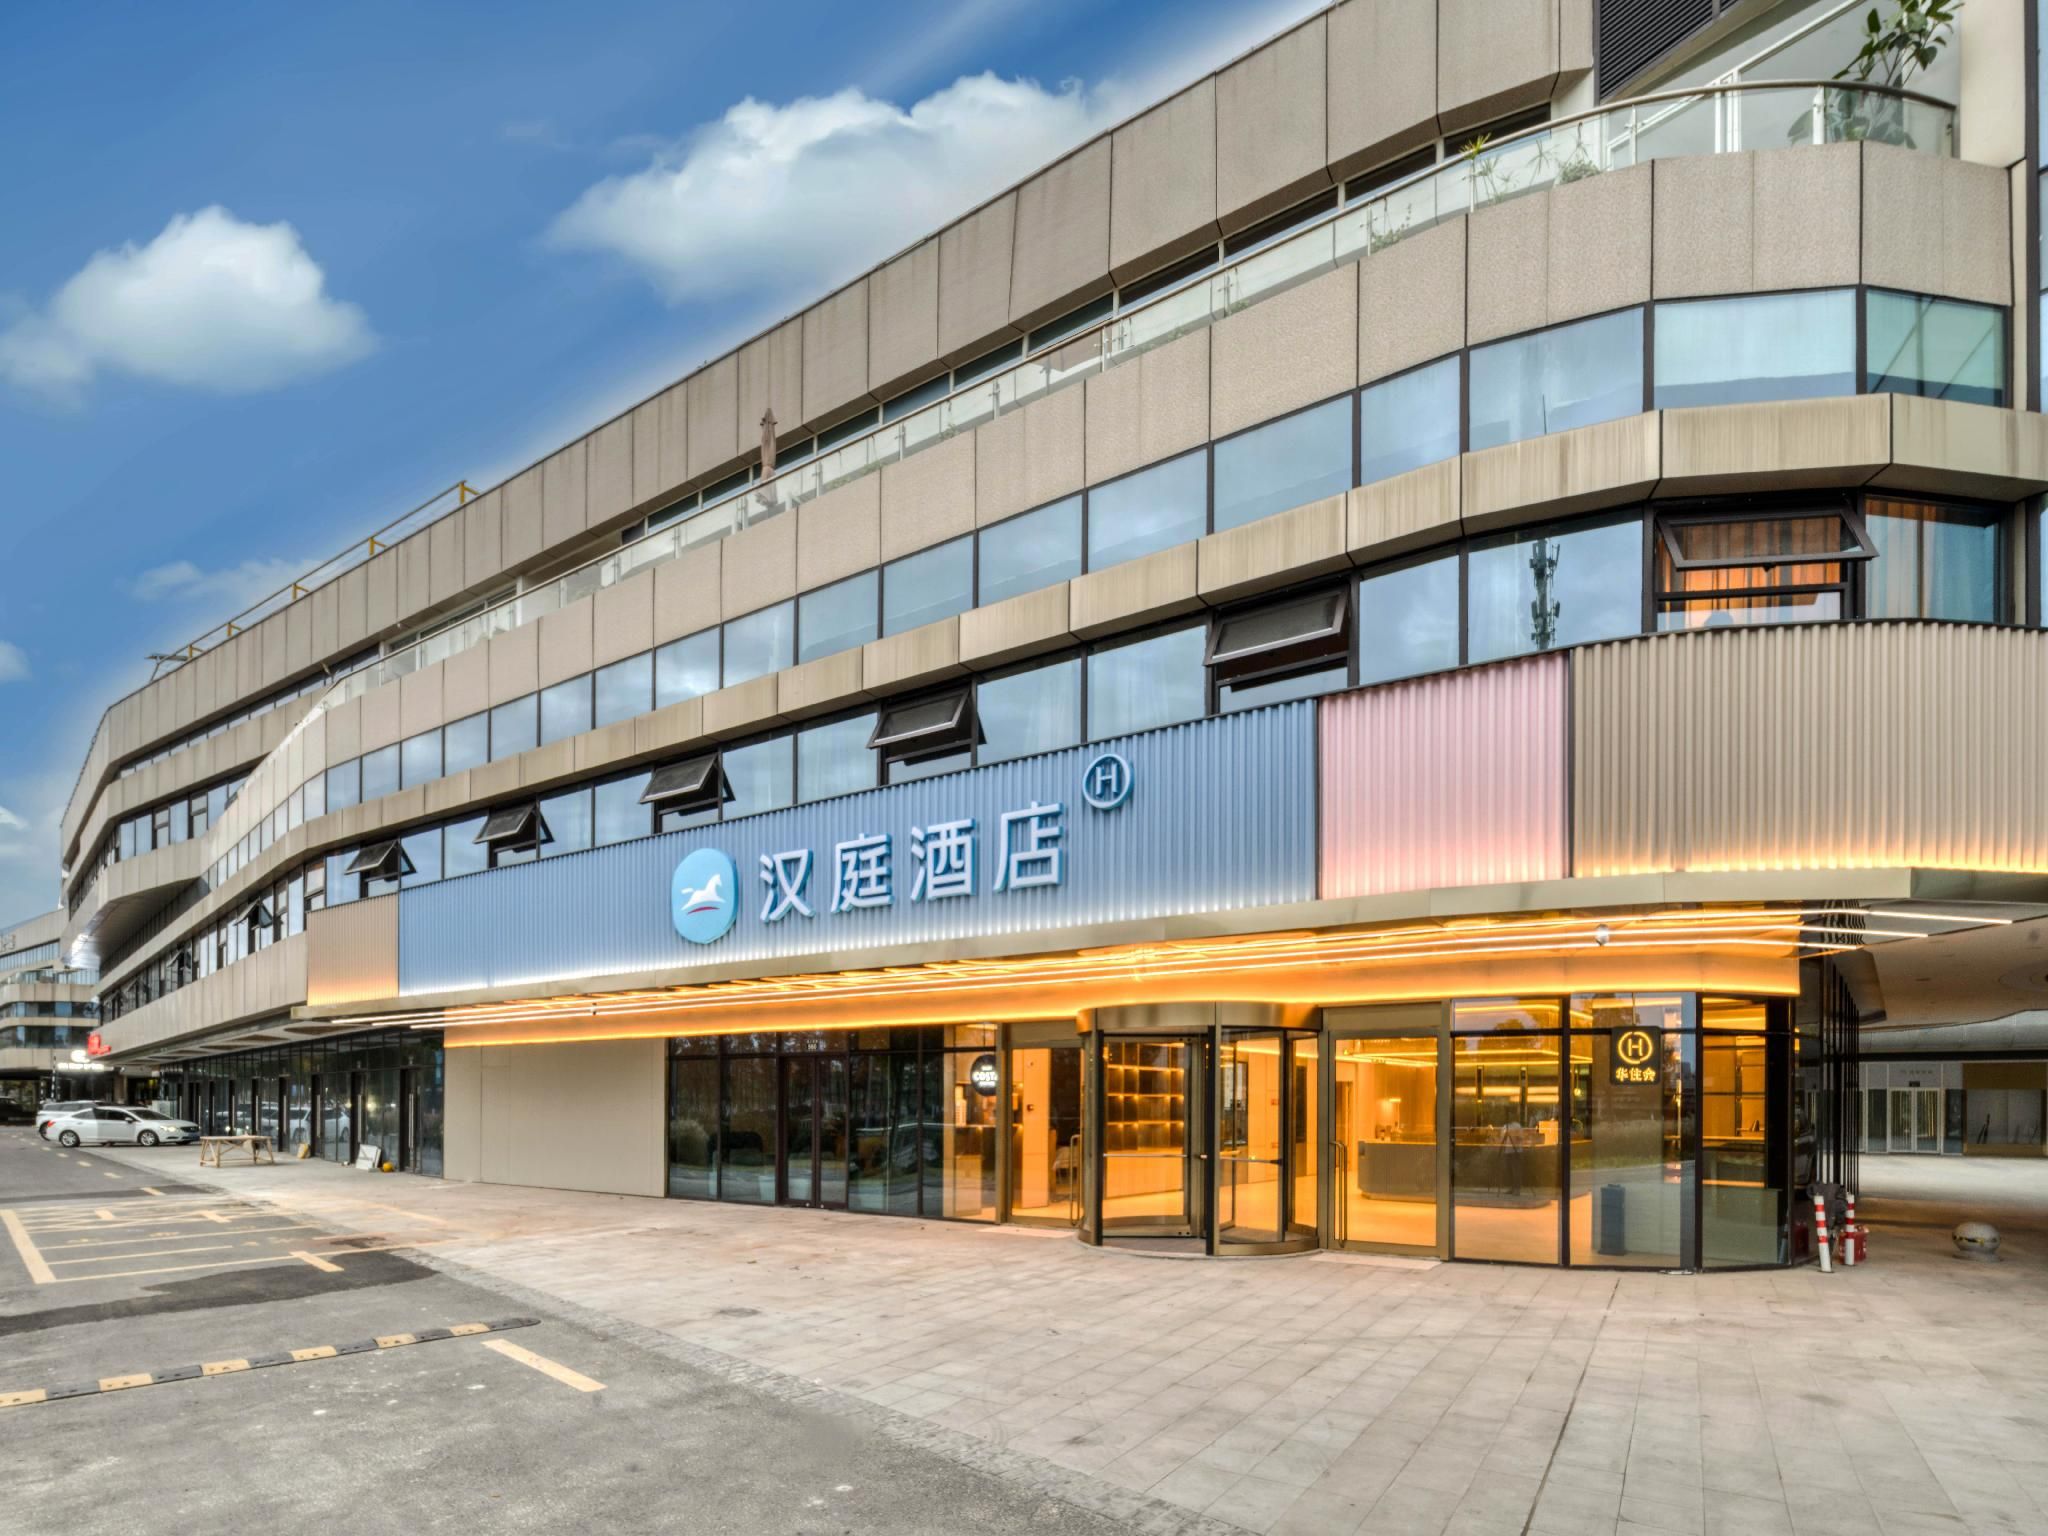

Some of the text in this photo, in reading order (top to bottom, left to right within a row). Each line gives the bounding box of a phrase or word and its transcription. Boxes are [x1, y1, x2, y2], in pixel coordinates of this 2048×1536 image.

[760, 801, 1063, 923] 汉庭酒店
[1616, 1067, 1656, 1082] 华住会
